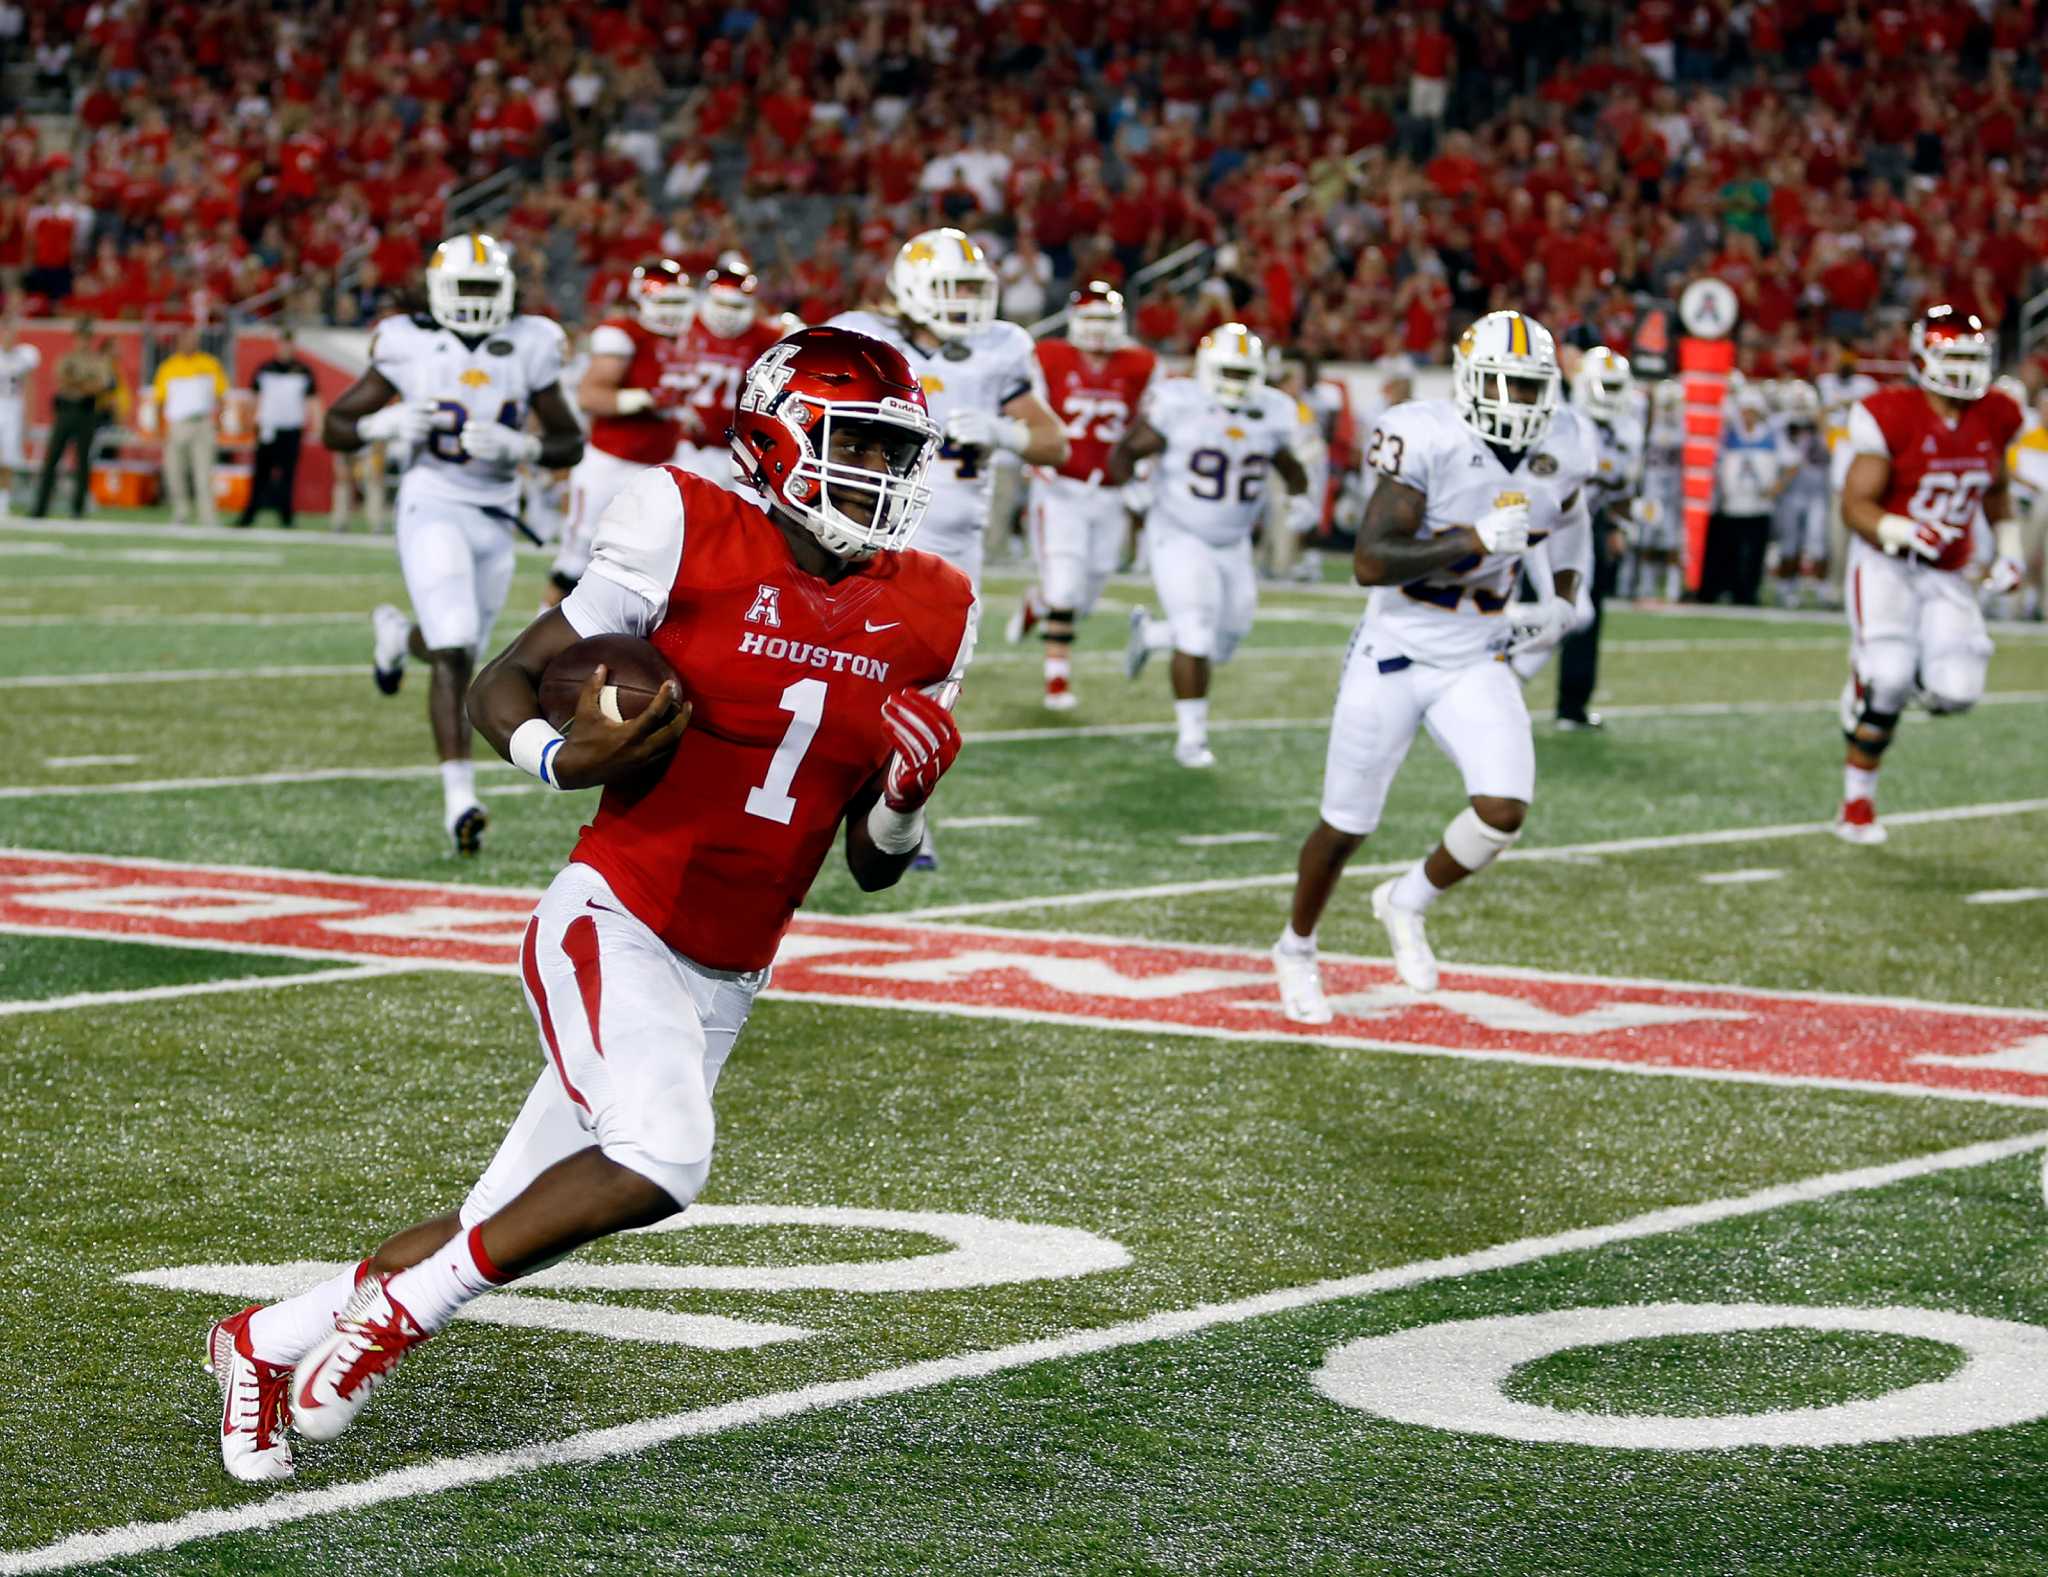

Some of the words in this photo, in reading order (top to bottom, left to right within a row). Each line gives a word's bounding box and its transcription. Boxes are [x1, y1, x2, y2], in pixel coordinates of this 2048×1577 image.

[690, 361, 742, 409] 71
[1060, 397, 1130, 443] 73
[1188, 447, 1266, 503] 92
[1366, 426, 1405, 477] 23
[744, 584, 782, 628] A
[737, 631, 890, 683] HOUSTON
[744, 677, 828, 826] 1
